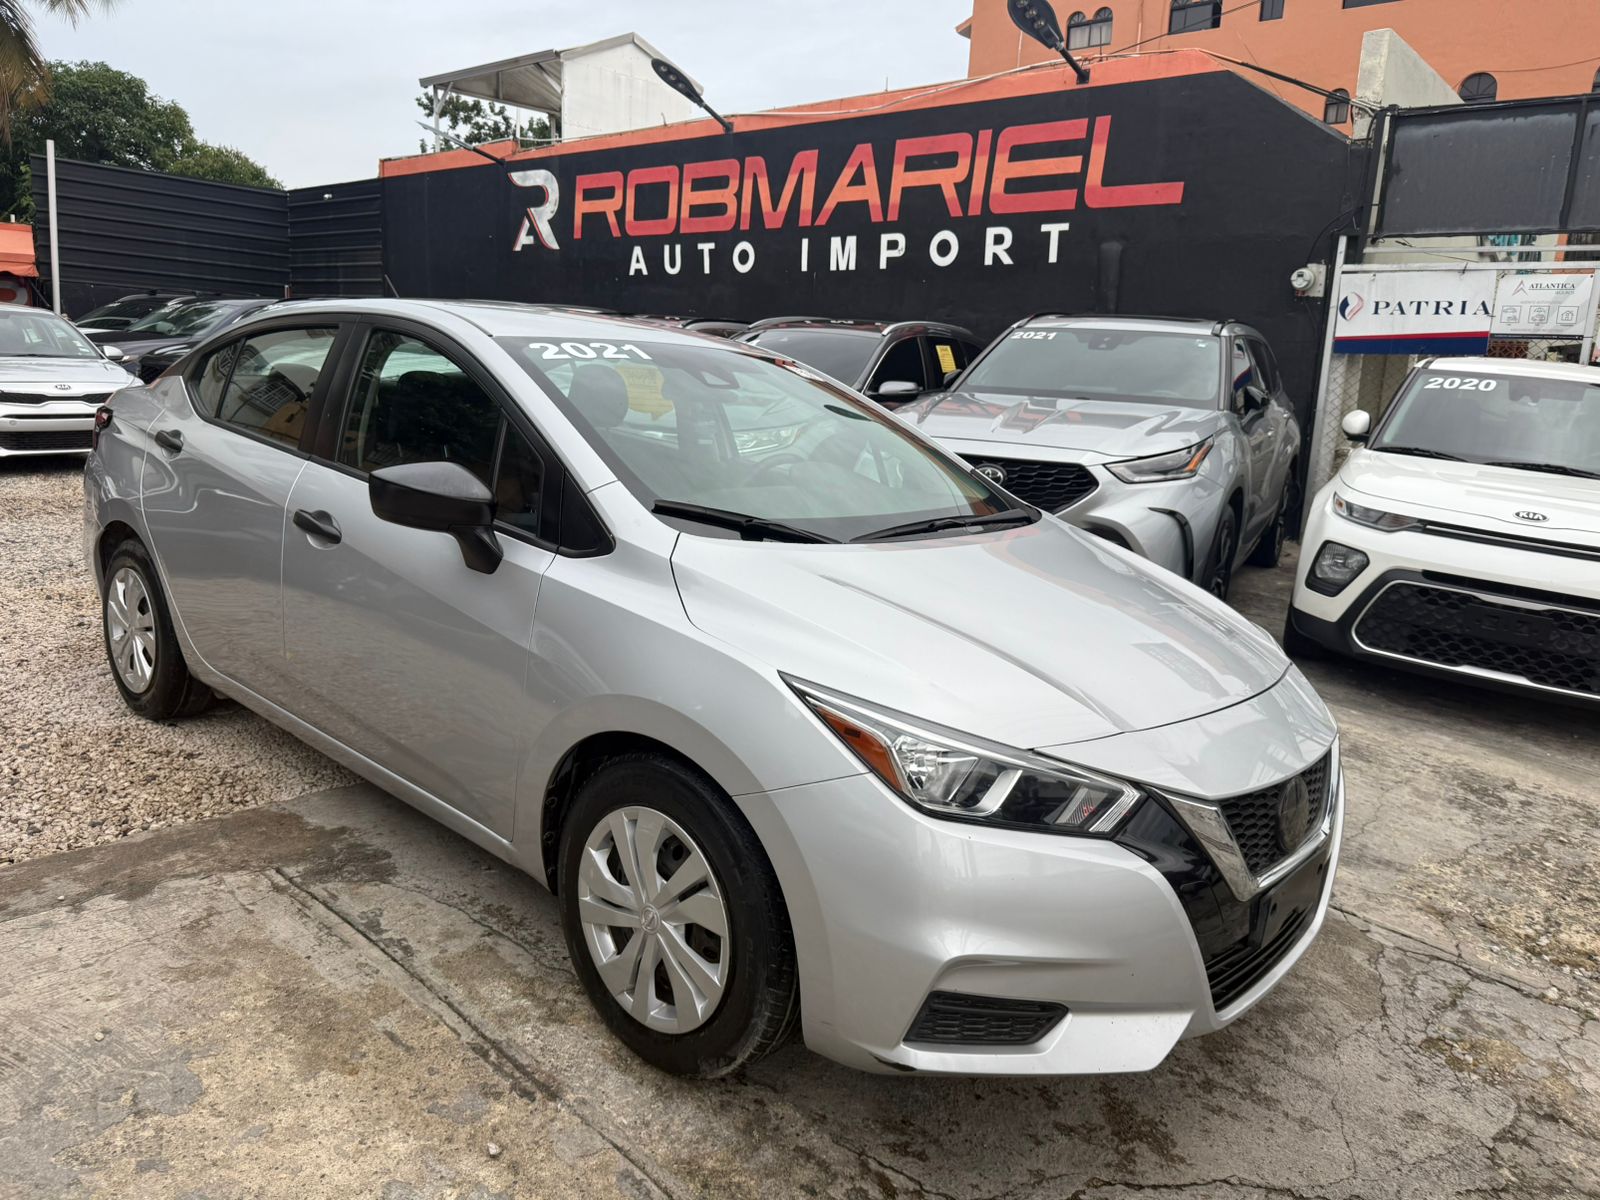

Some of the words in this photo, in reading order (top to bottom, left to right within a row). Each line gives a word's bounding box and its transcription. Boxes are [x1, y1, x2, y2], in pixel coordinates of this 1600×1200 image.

[573, 115, 1185, 240] ROBMARIEL
[628, 241, 756, 276] AUTO
[801, 222, 1070, 273] IMPORT
[1373, 300, 1493, 316] PATRIA
[1011, 331, 1057, 340] 2021
[529, 342, 653, 360] 2021
[1423, 377, 1497, 392] 2020
[1517, 510, 1545, 521] KIA
